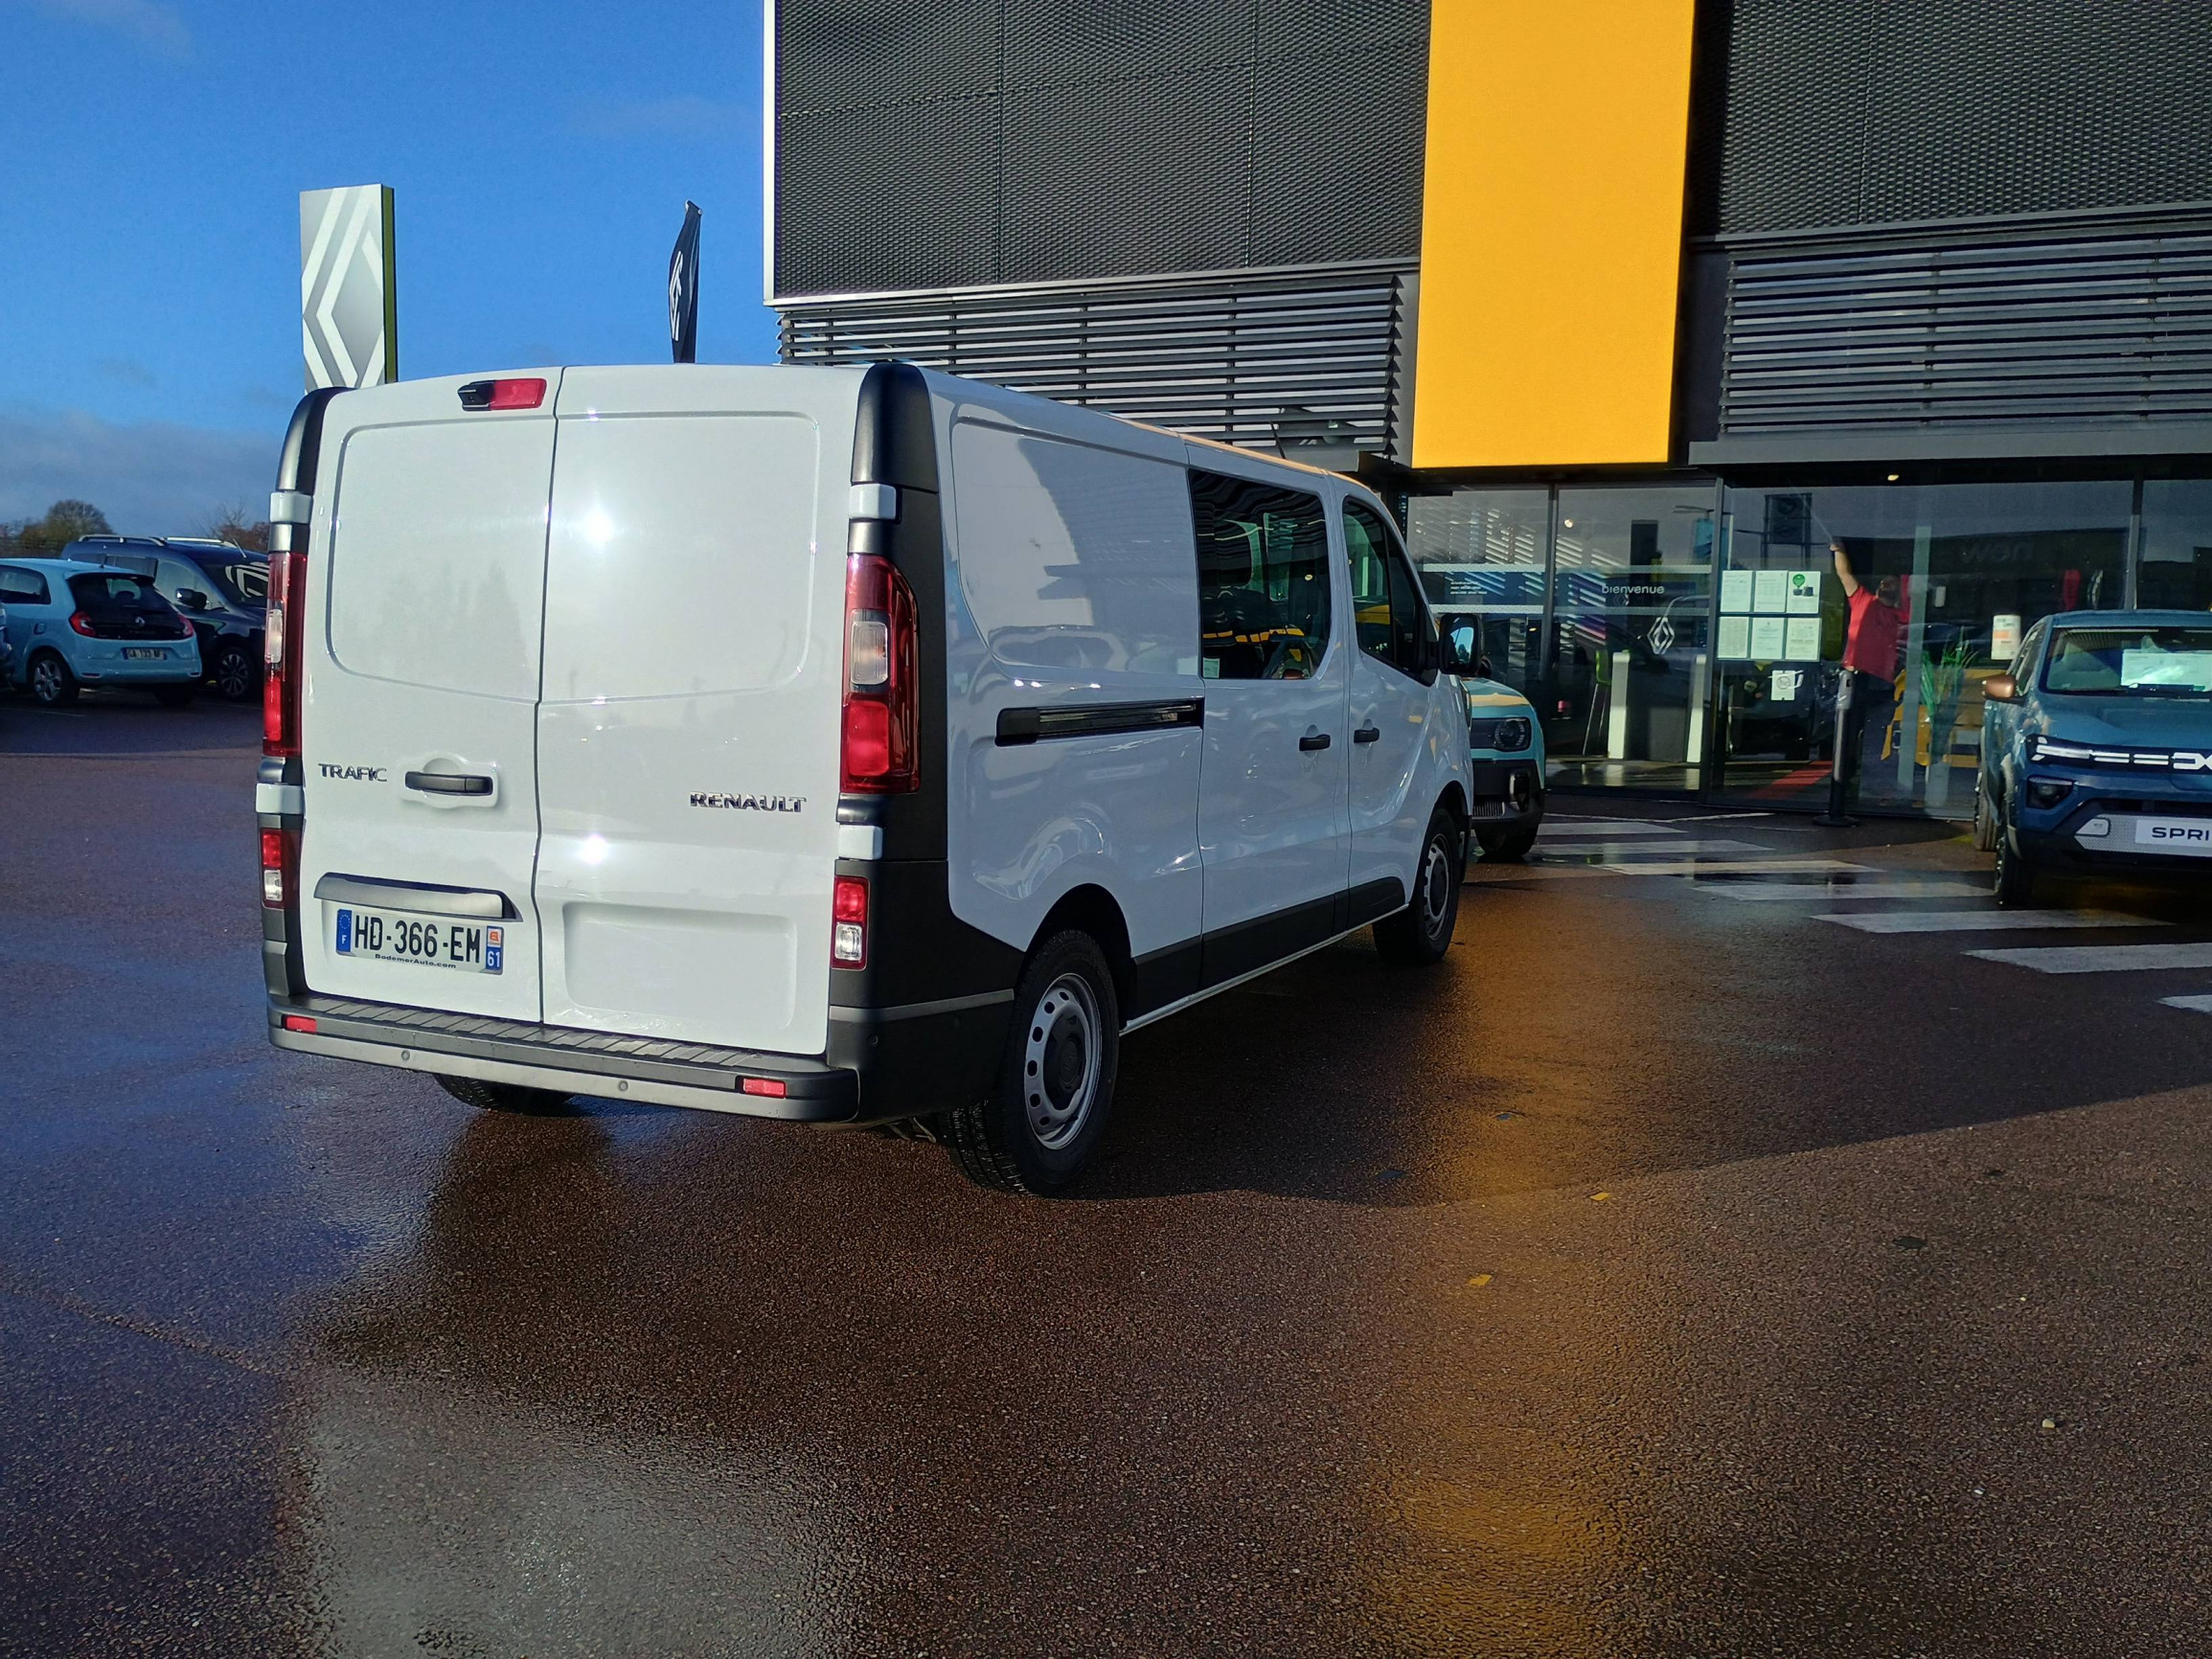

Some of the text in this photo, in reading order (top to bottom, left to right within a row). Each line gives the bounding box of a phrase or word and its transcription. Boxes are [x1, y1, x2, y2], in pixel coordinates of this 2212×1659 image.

[1602, 583, 1665, 594] bienvenue
[318, 762, 387, 783] TRAFIC
[690, 790, 807, 813] RENAULT
[341, 934, 347, 944] F
[375, 953, 457, 969] BodemerAuto.com
[487, 950, 501, 967] 61
